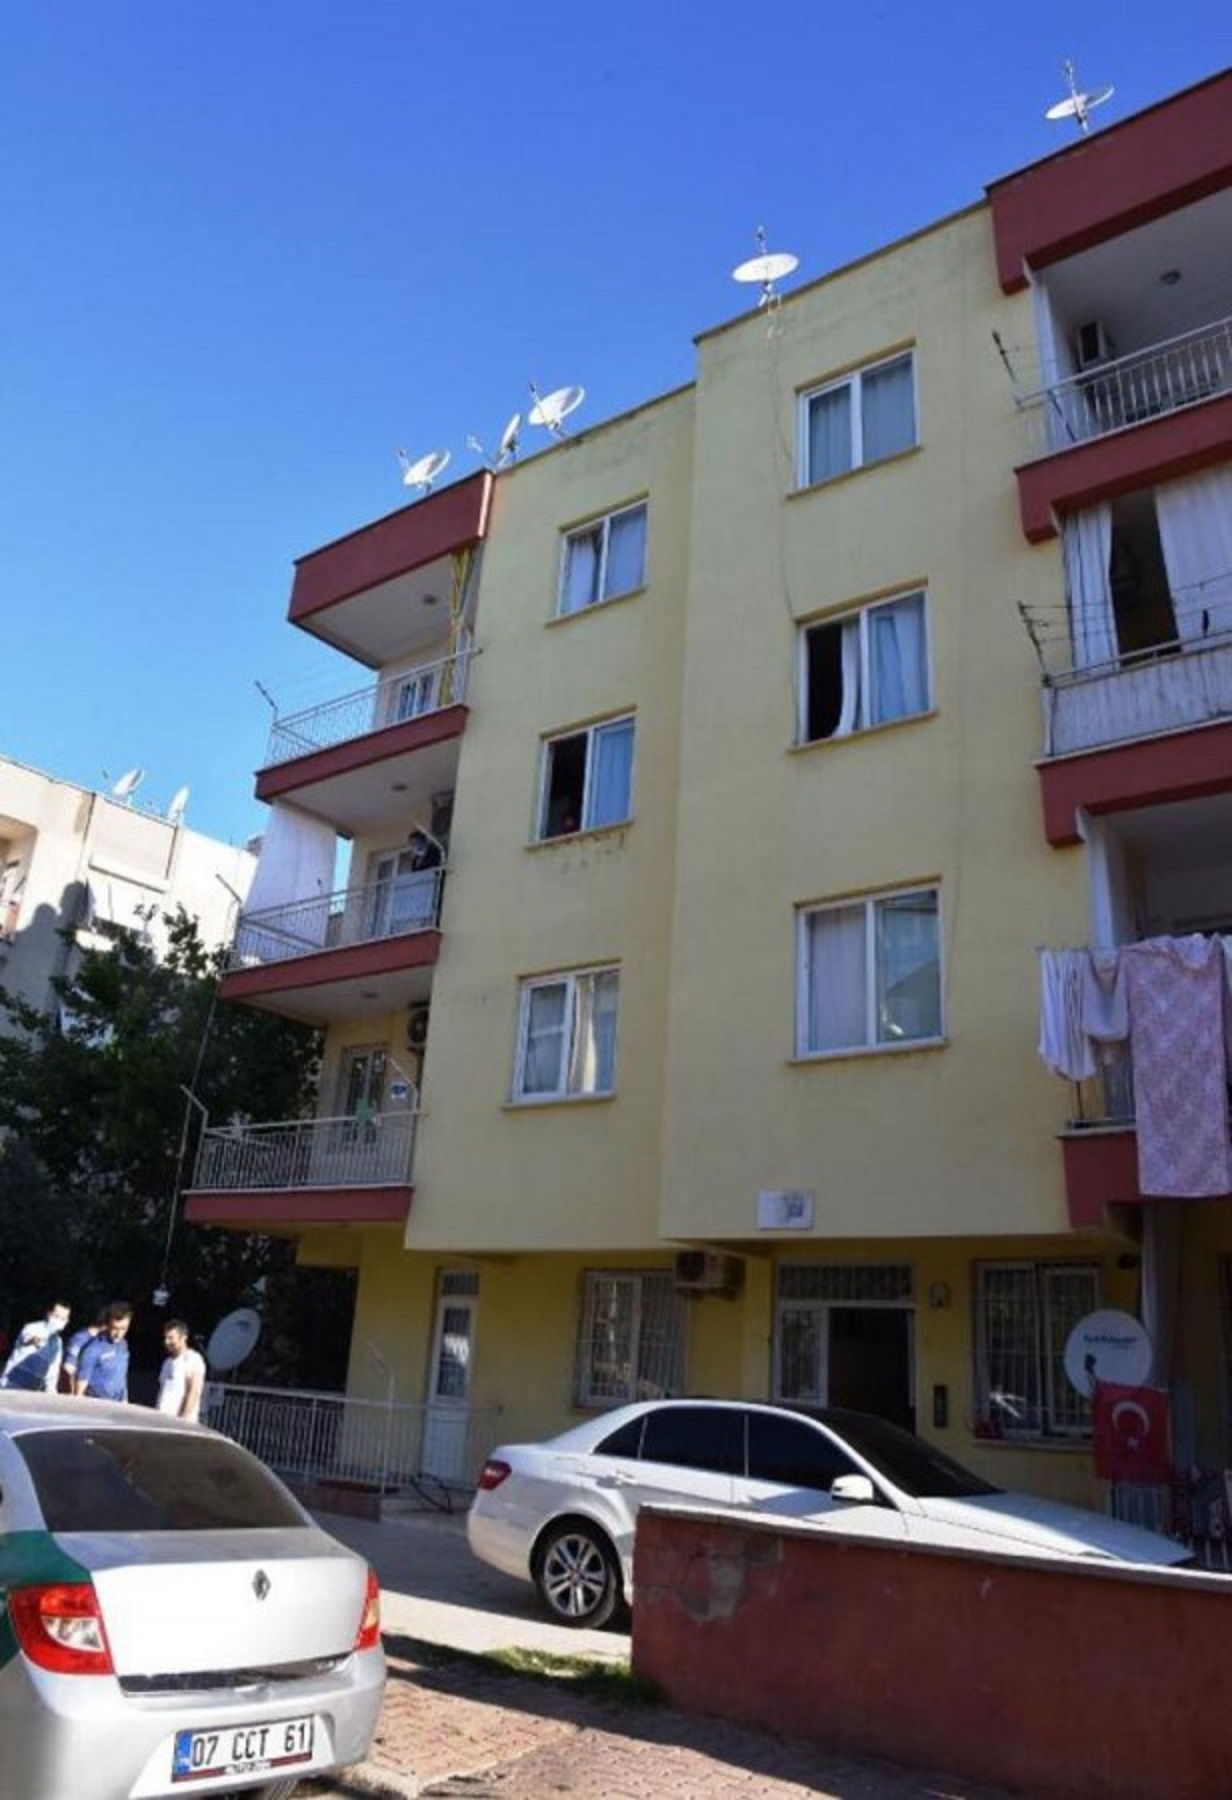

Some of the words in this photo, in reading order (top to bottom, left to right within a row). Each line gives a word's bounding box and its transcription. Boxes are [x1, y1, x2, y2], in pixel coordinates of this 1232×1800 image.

[191, 1735, 219, 1767] 07
[231, 1727, 270, 1761] CCT
[284, 1722, 306, 1752] 61
